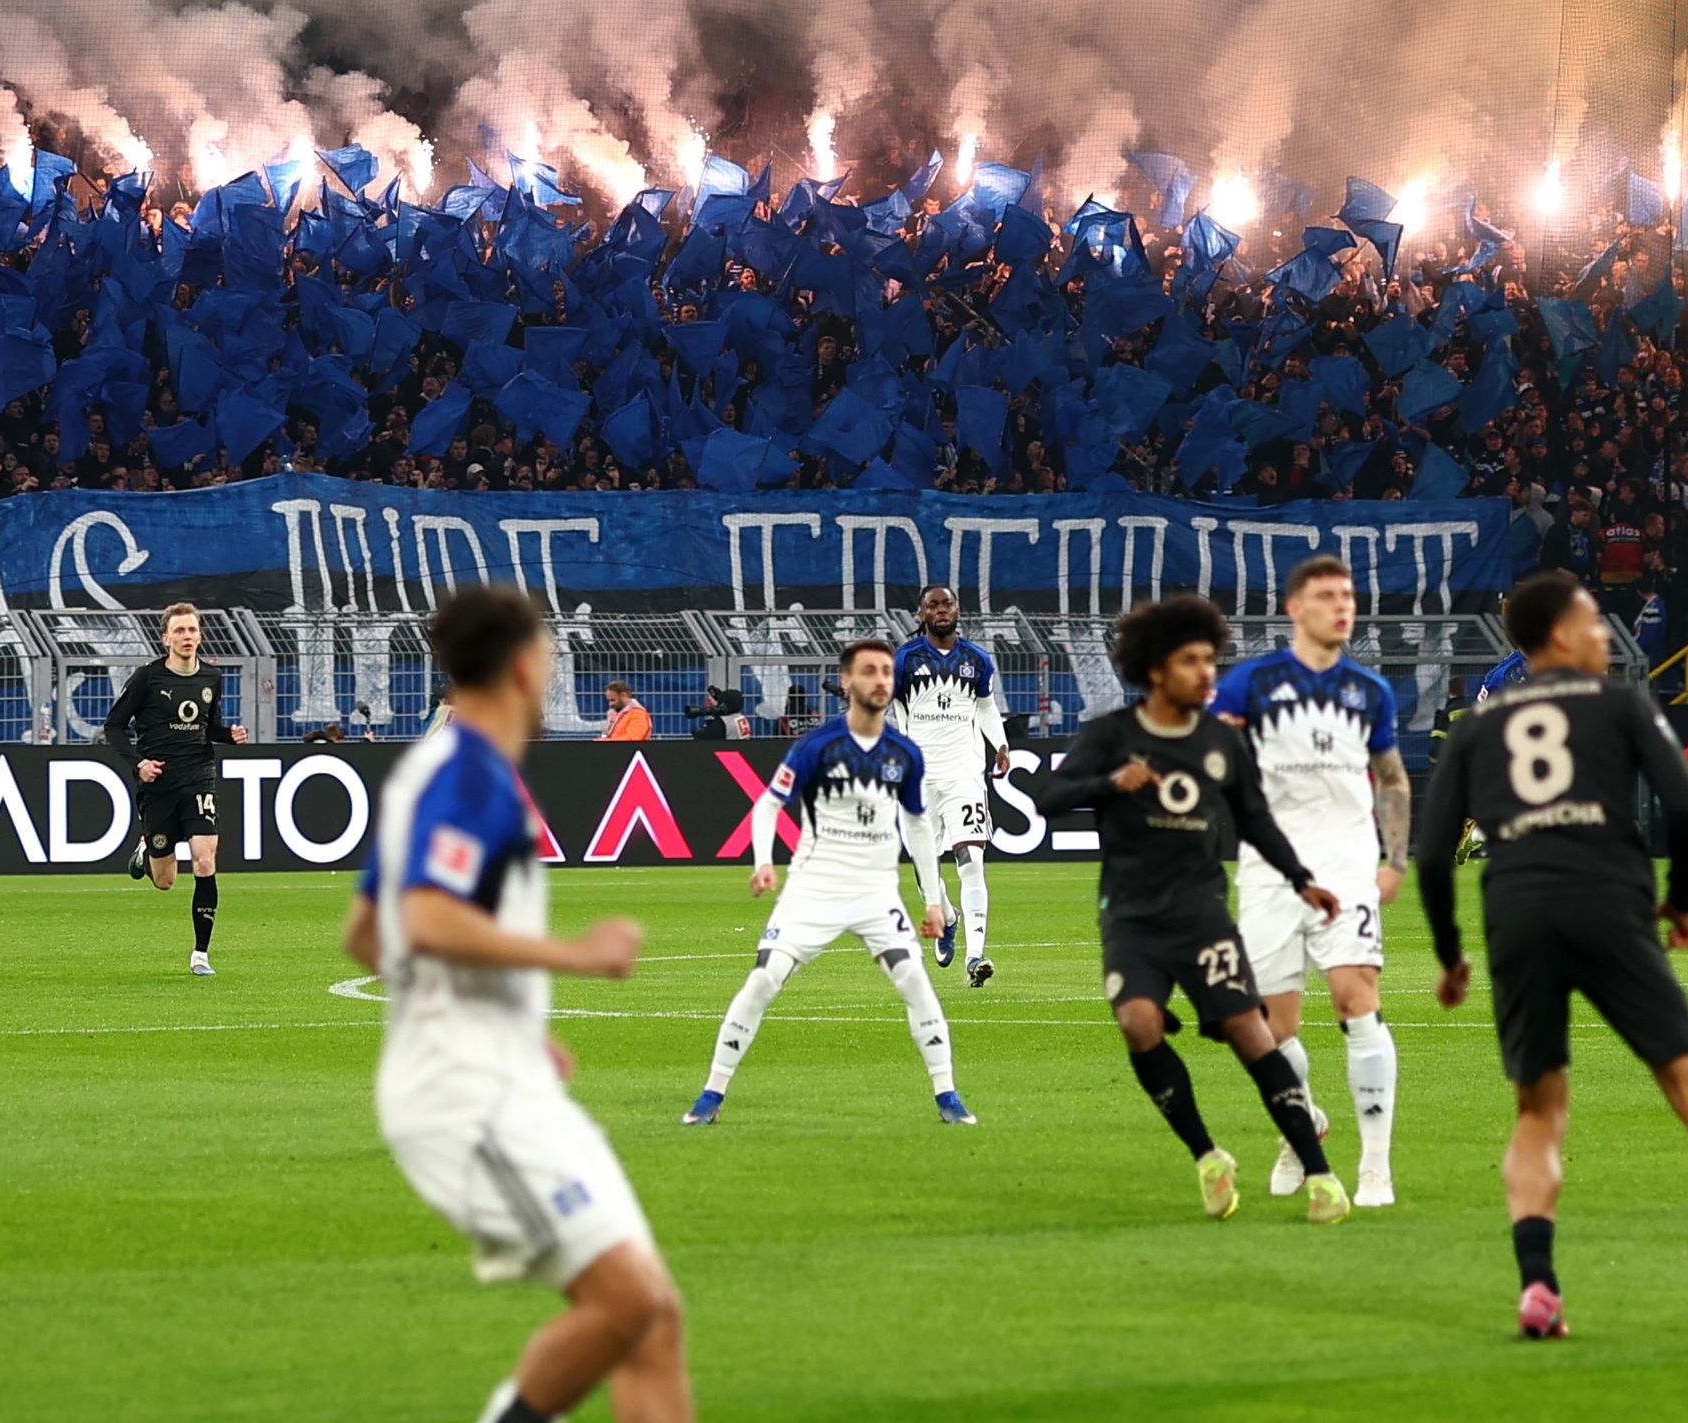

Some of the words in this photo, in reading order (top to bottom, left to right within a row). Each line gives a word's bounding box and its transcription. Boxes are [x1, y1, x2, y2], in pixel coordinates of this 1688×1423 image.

[1504, 702, 1574, 805] 8
[196, 794, 216, 815] 14
[223, 754, 370, 864] TO
[962, 803, 986, 827] 25
[1356, 905, 1379, 939] 2
